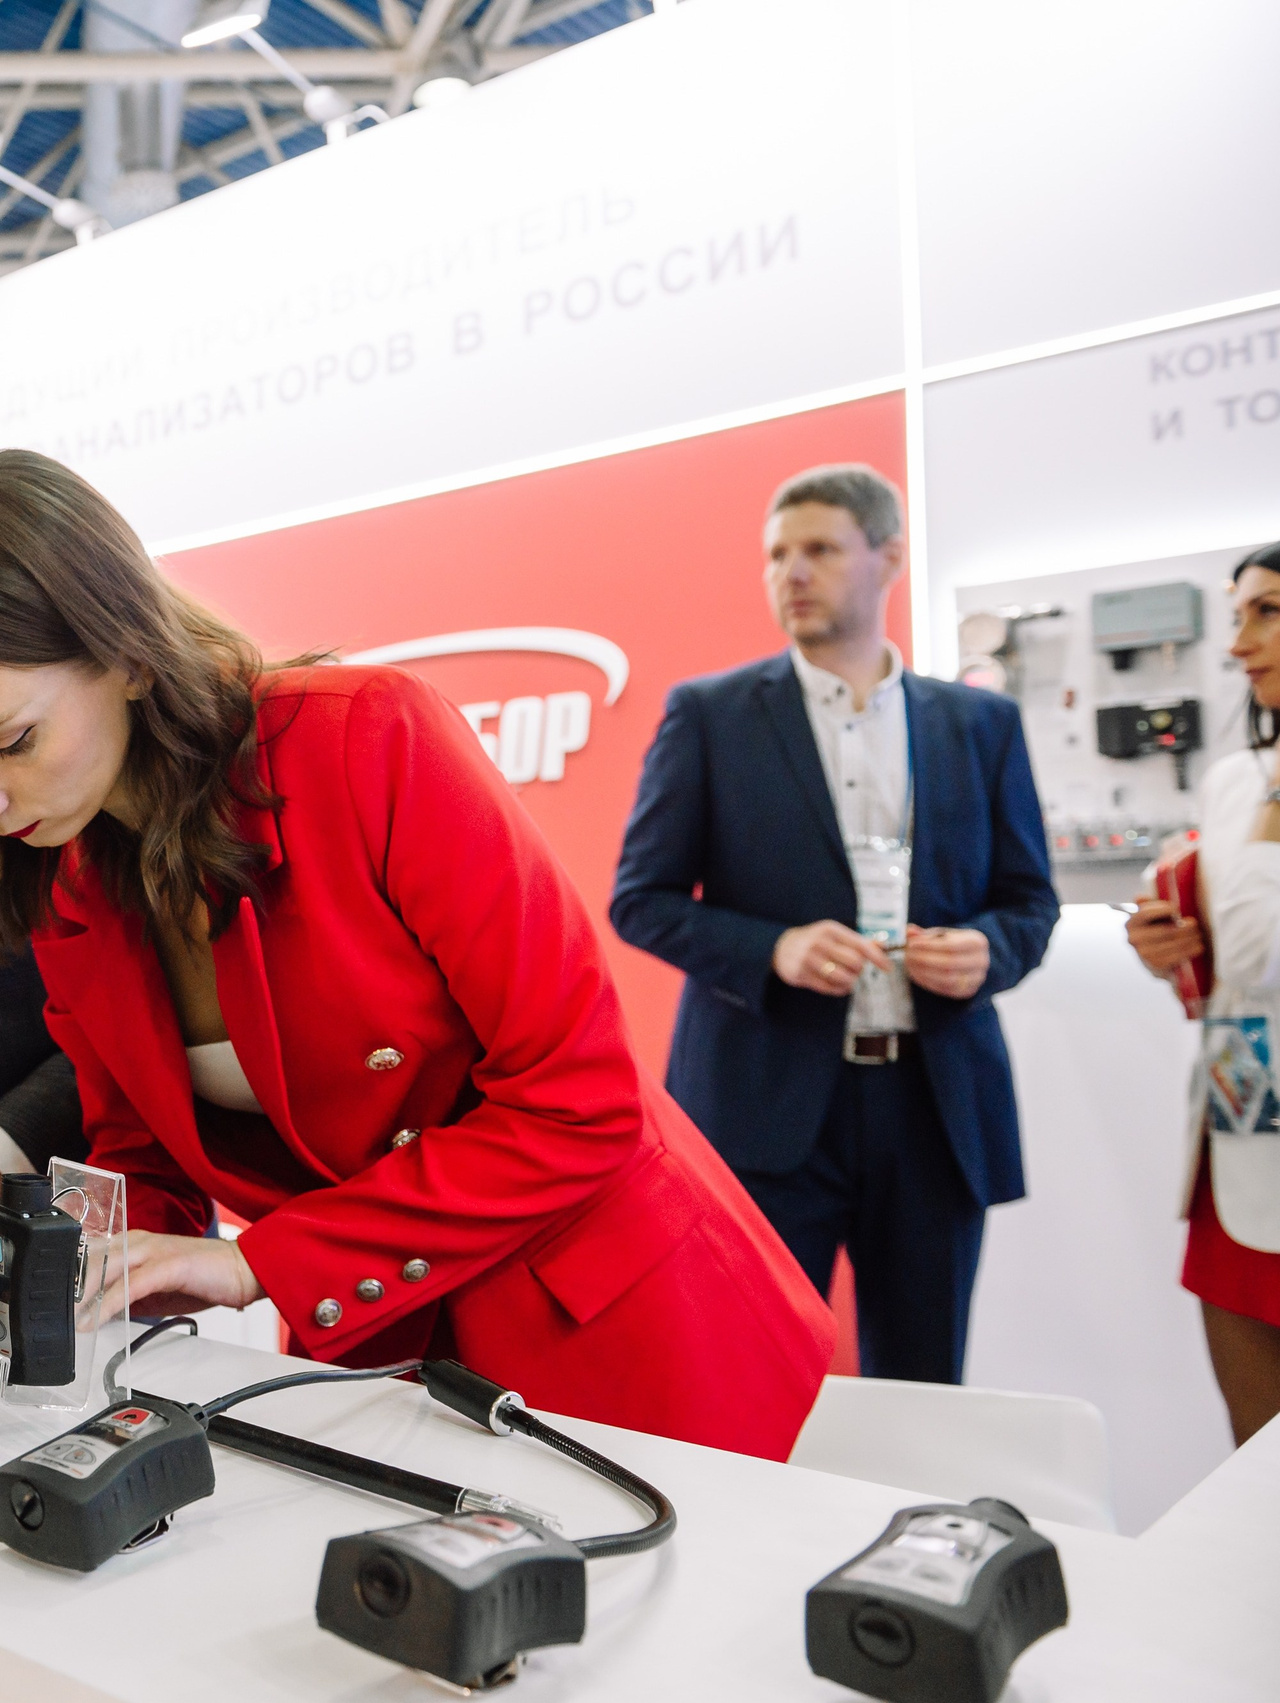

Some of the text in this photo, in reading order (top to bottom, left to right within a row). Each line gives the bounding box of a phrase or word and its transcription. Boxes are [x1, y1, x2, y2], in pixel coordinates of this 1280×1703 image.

[32, 212, 802, 464] АНАЛИЗАТОРОВ В РОССИИ
[170, 187, 636, 364] ПРОИЗВОДИТЕЛЬ
[1151, 407, 1183, 443] И
